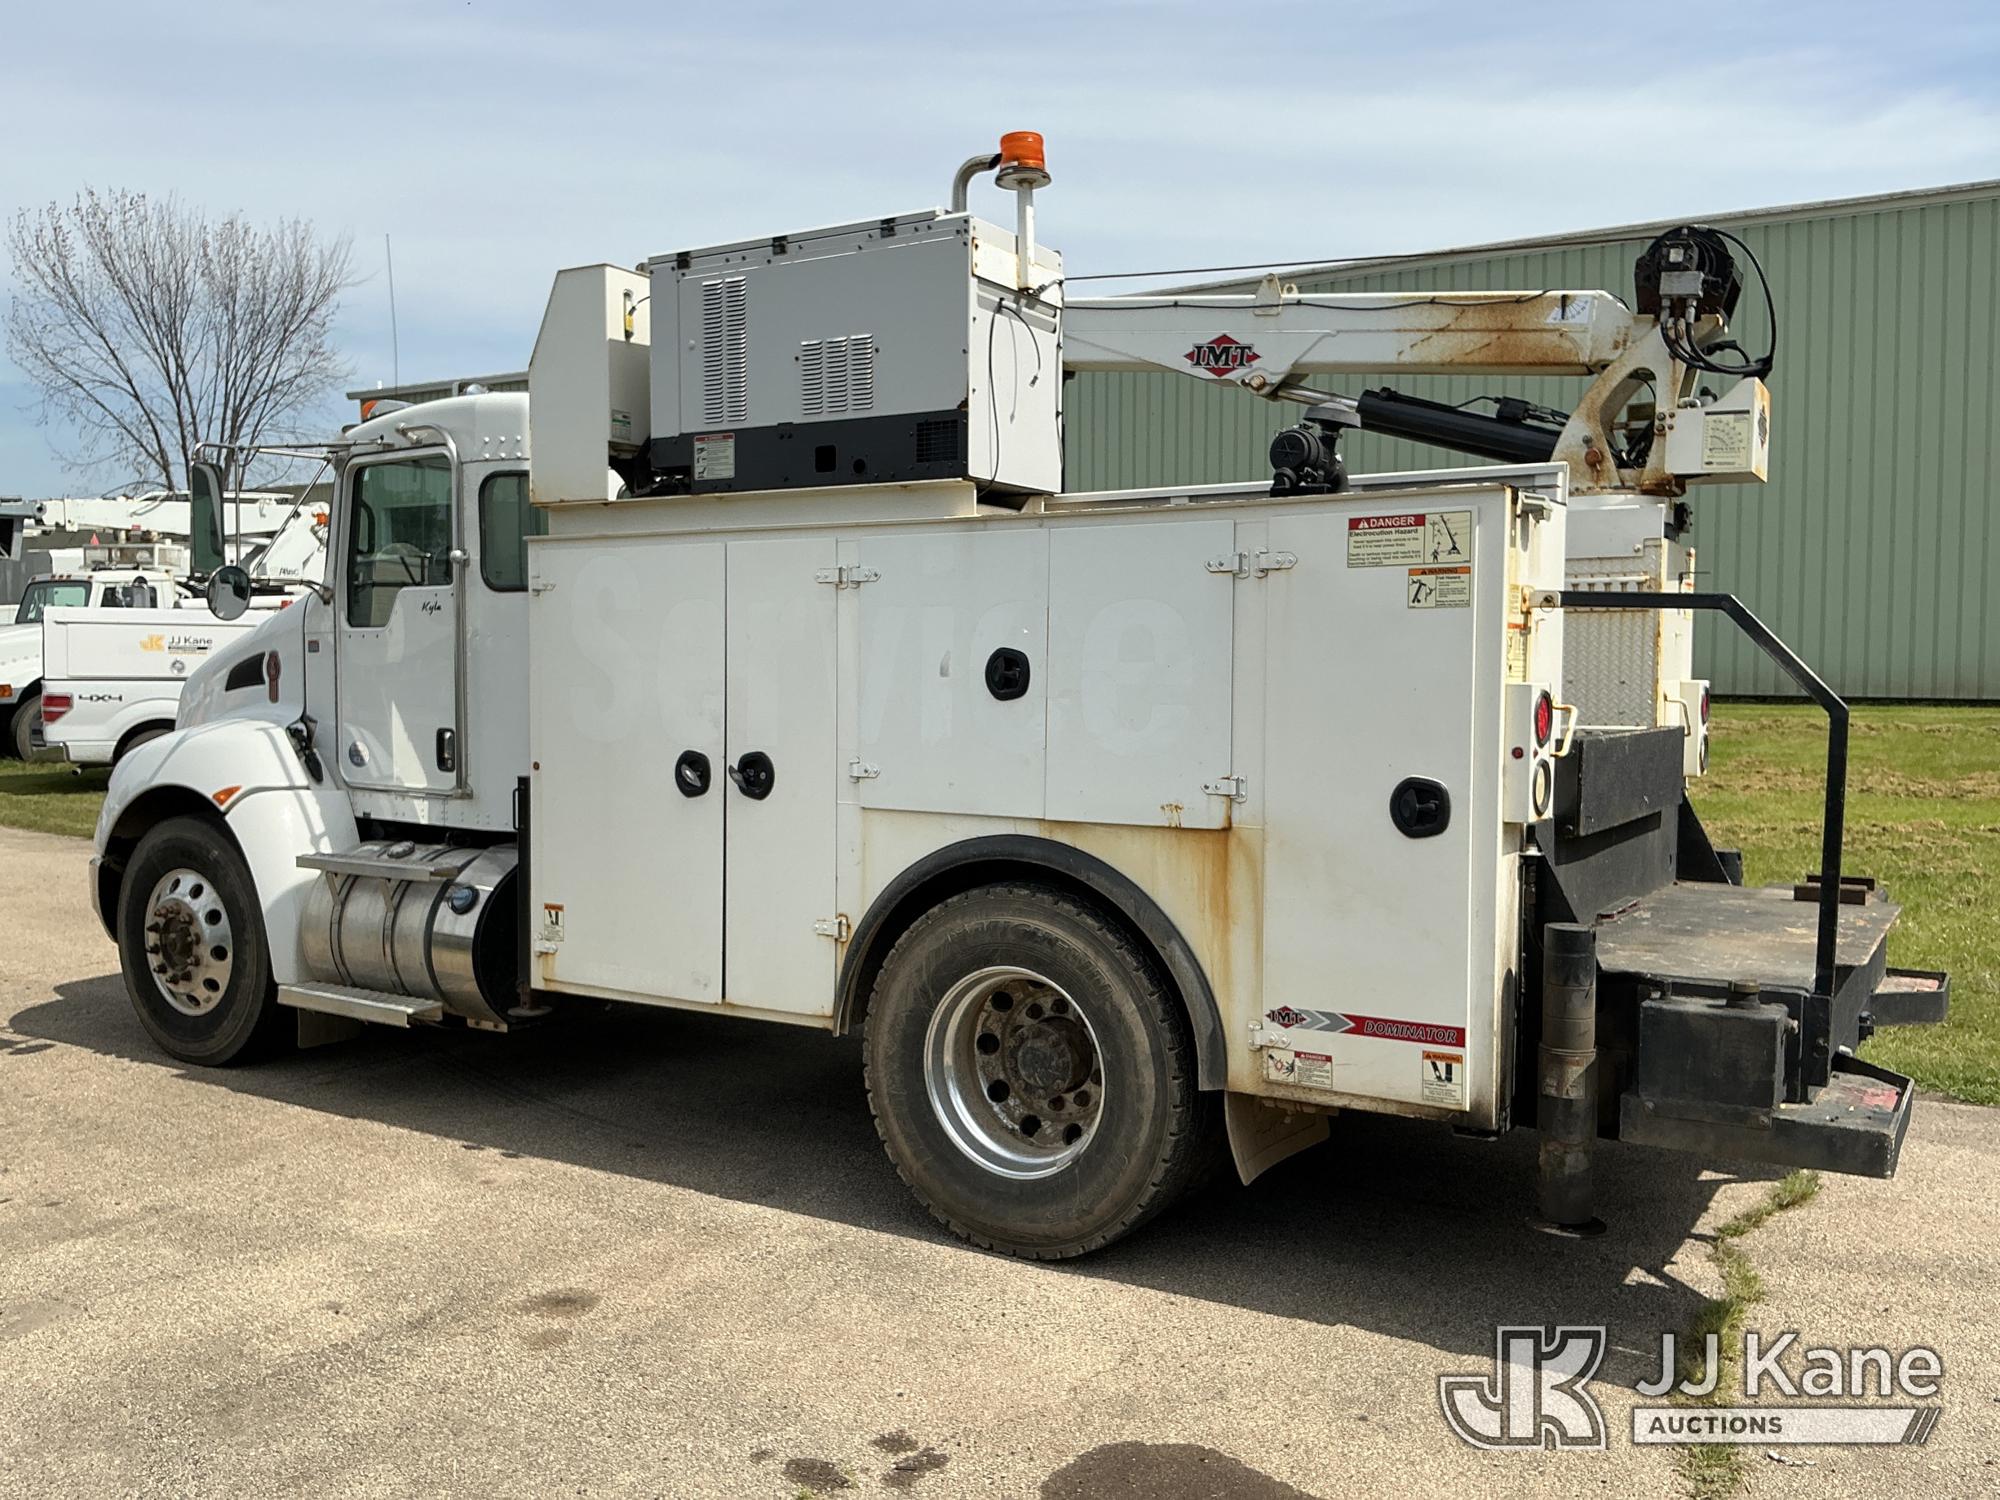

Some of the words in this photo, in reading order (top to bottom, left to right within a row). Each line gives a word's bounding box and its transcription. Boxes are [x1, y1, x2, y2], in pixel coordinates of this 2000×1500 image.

[1190, 343, 1254, 369] IMT
[1370, 516, 1415, 528] DANGER
[1349, 530, 1392, 538] Electrocution
[421, 600, 442, 616] Kyle
[183, 635, 213, 644] Kane
[1269, 1009, 1302, 1026] IMT
[1363, 1020, 1457, 1043] DOMINATOR
